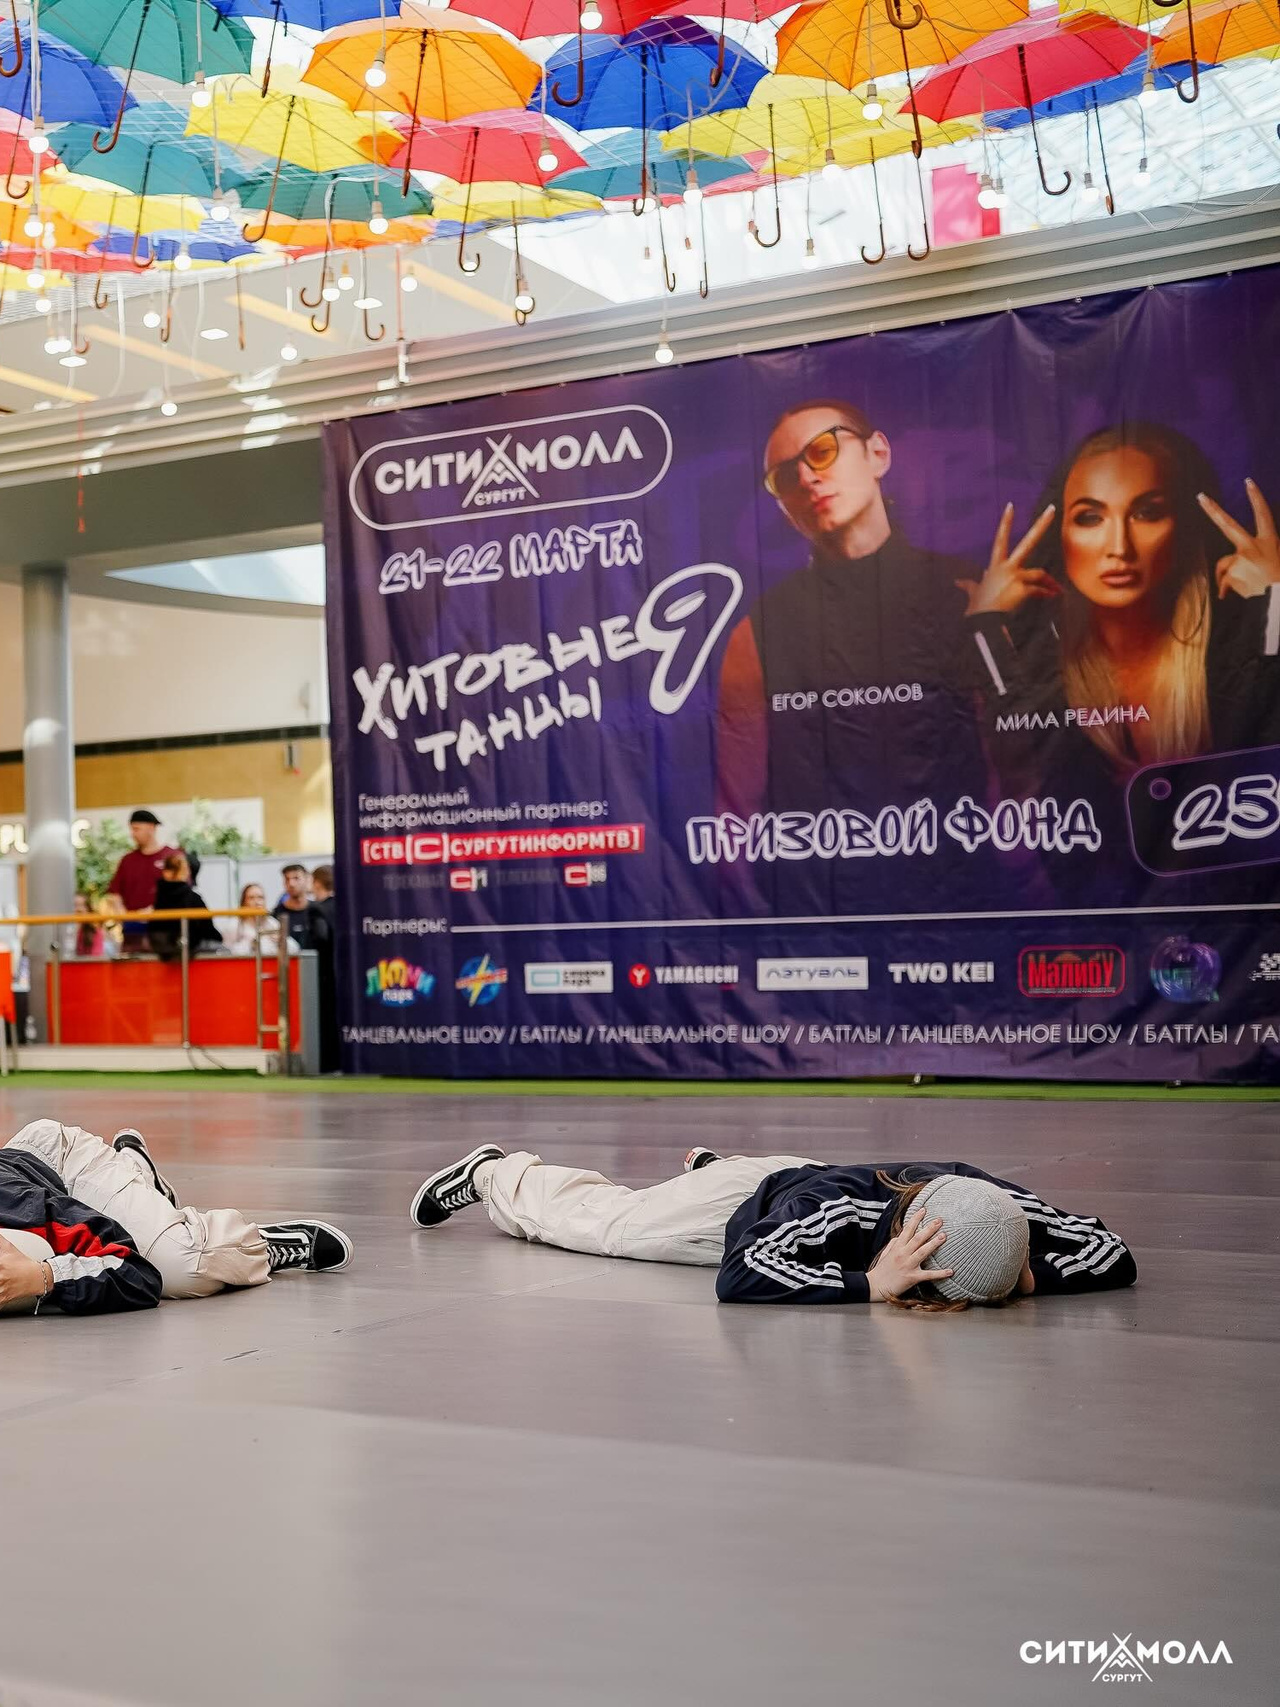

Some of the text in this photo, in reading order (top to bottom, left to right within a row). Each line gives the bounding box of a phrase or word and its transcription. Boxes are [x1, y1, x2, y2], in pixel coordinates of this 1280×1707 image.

[375, 426, 644, 494] СИТИ МОЛЛ
[473, 487, 526, 507] СУРГУТ
[379, 518, 643, 594] 21-22 МАРТА
[352, 614, 641, 739] ХИТОВЫЕ
[772, 683, 923, 712] ЕГОР СОКОЛОВ
[415, 677, 602, 771] ТАНЦЫ
[996, 704, 1150, 732] МИЛА РЕДИНА
[359, 787, 470, 811] Генеральный
[1172, 774, 1280, 851] 25
[359, 801, 609, 831] информационный партнер:
[686, 796, 1102, 863] ПРИЗОВОЙ ФОНД
[363, 917, 447, 938] Партнеры:
[655, 965, 739, 985] YAMAGUCHI
[888, 961, 995, 984] TWO KEI
[342, 1024, 461, 1044] ТАНЦЕВАЛЬНОЕ
[464, 1024, 506, 1044] ШОУ
[520, 1024, 582, 1044] БАТТЛЫ
[598, 1024, 738, 1044] ТАНЦЕВАЛЬНОЕ
[741, 1024, 790, 1044] ШОУ
[808, 1024, 880, 1044] БАТТЛЫ
[900, 1024, 1061, 1044] ТАНЦЕВАЛЬНОЕ
[1066, 1024, 1122, 1044] ШОУ
[1144, 1024, 1227, 1044] БАТТЛЫ
[1251, 1024, 1280, 1044] ТА
